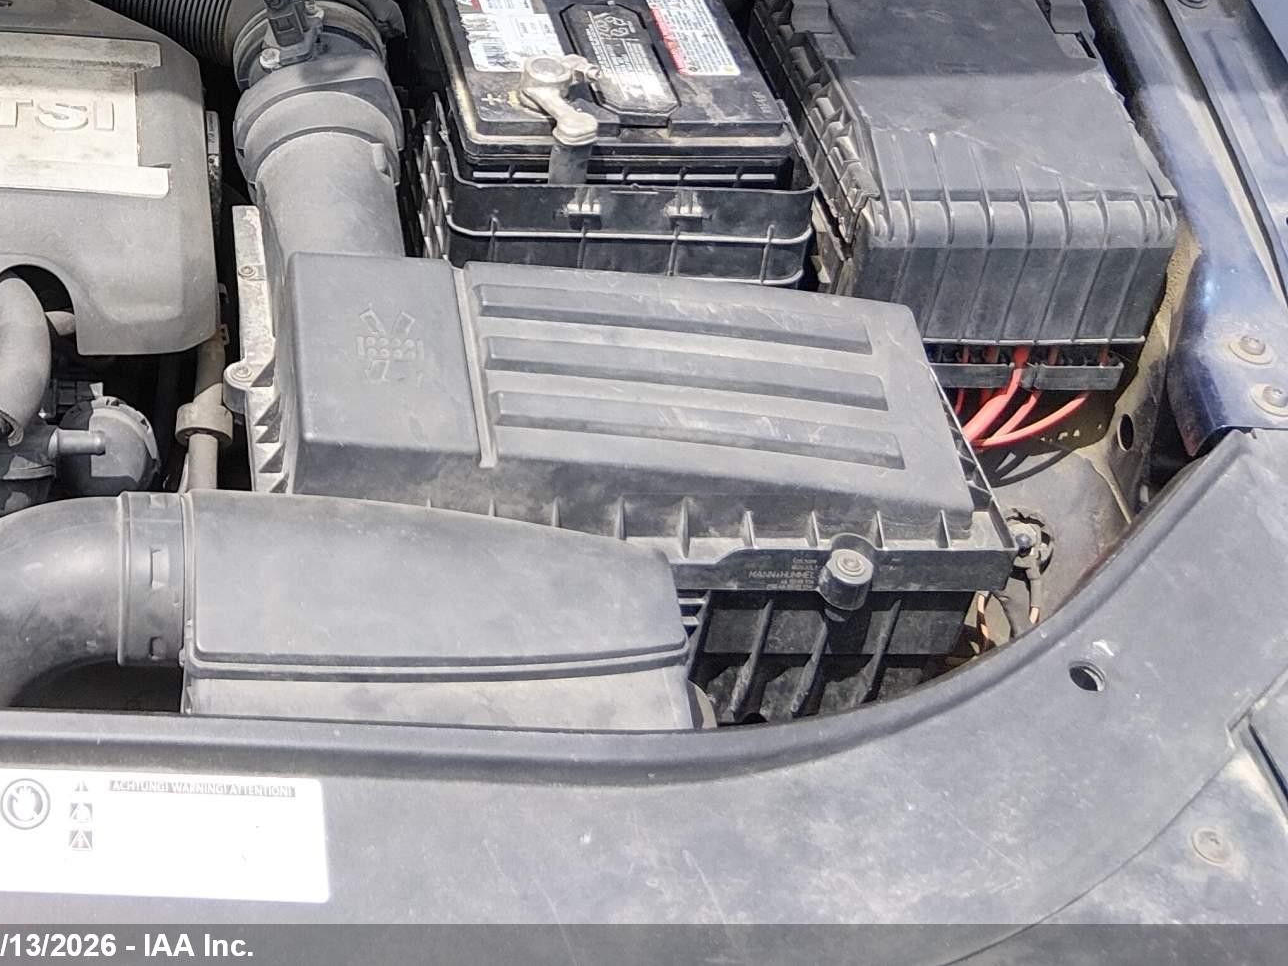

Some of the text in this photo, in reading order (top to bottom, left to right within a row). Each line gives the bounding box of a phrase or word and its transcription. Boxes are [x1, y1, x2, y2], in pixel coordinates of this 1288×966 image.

[111, 780, 294, 797] ACHTUNG! WARNING! ATTENTION!
